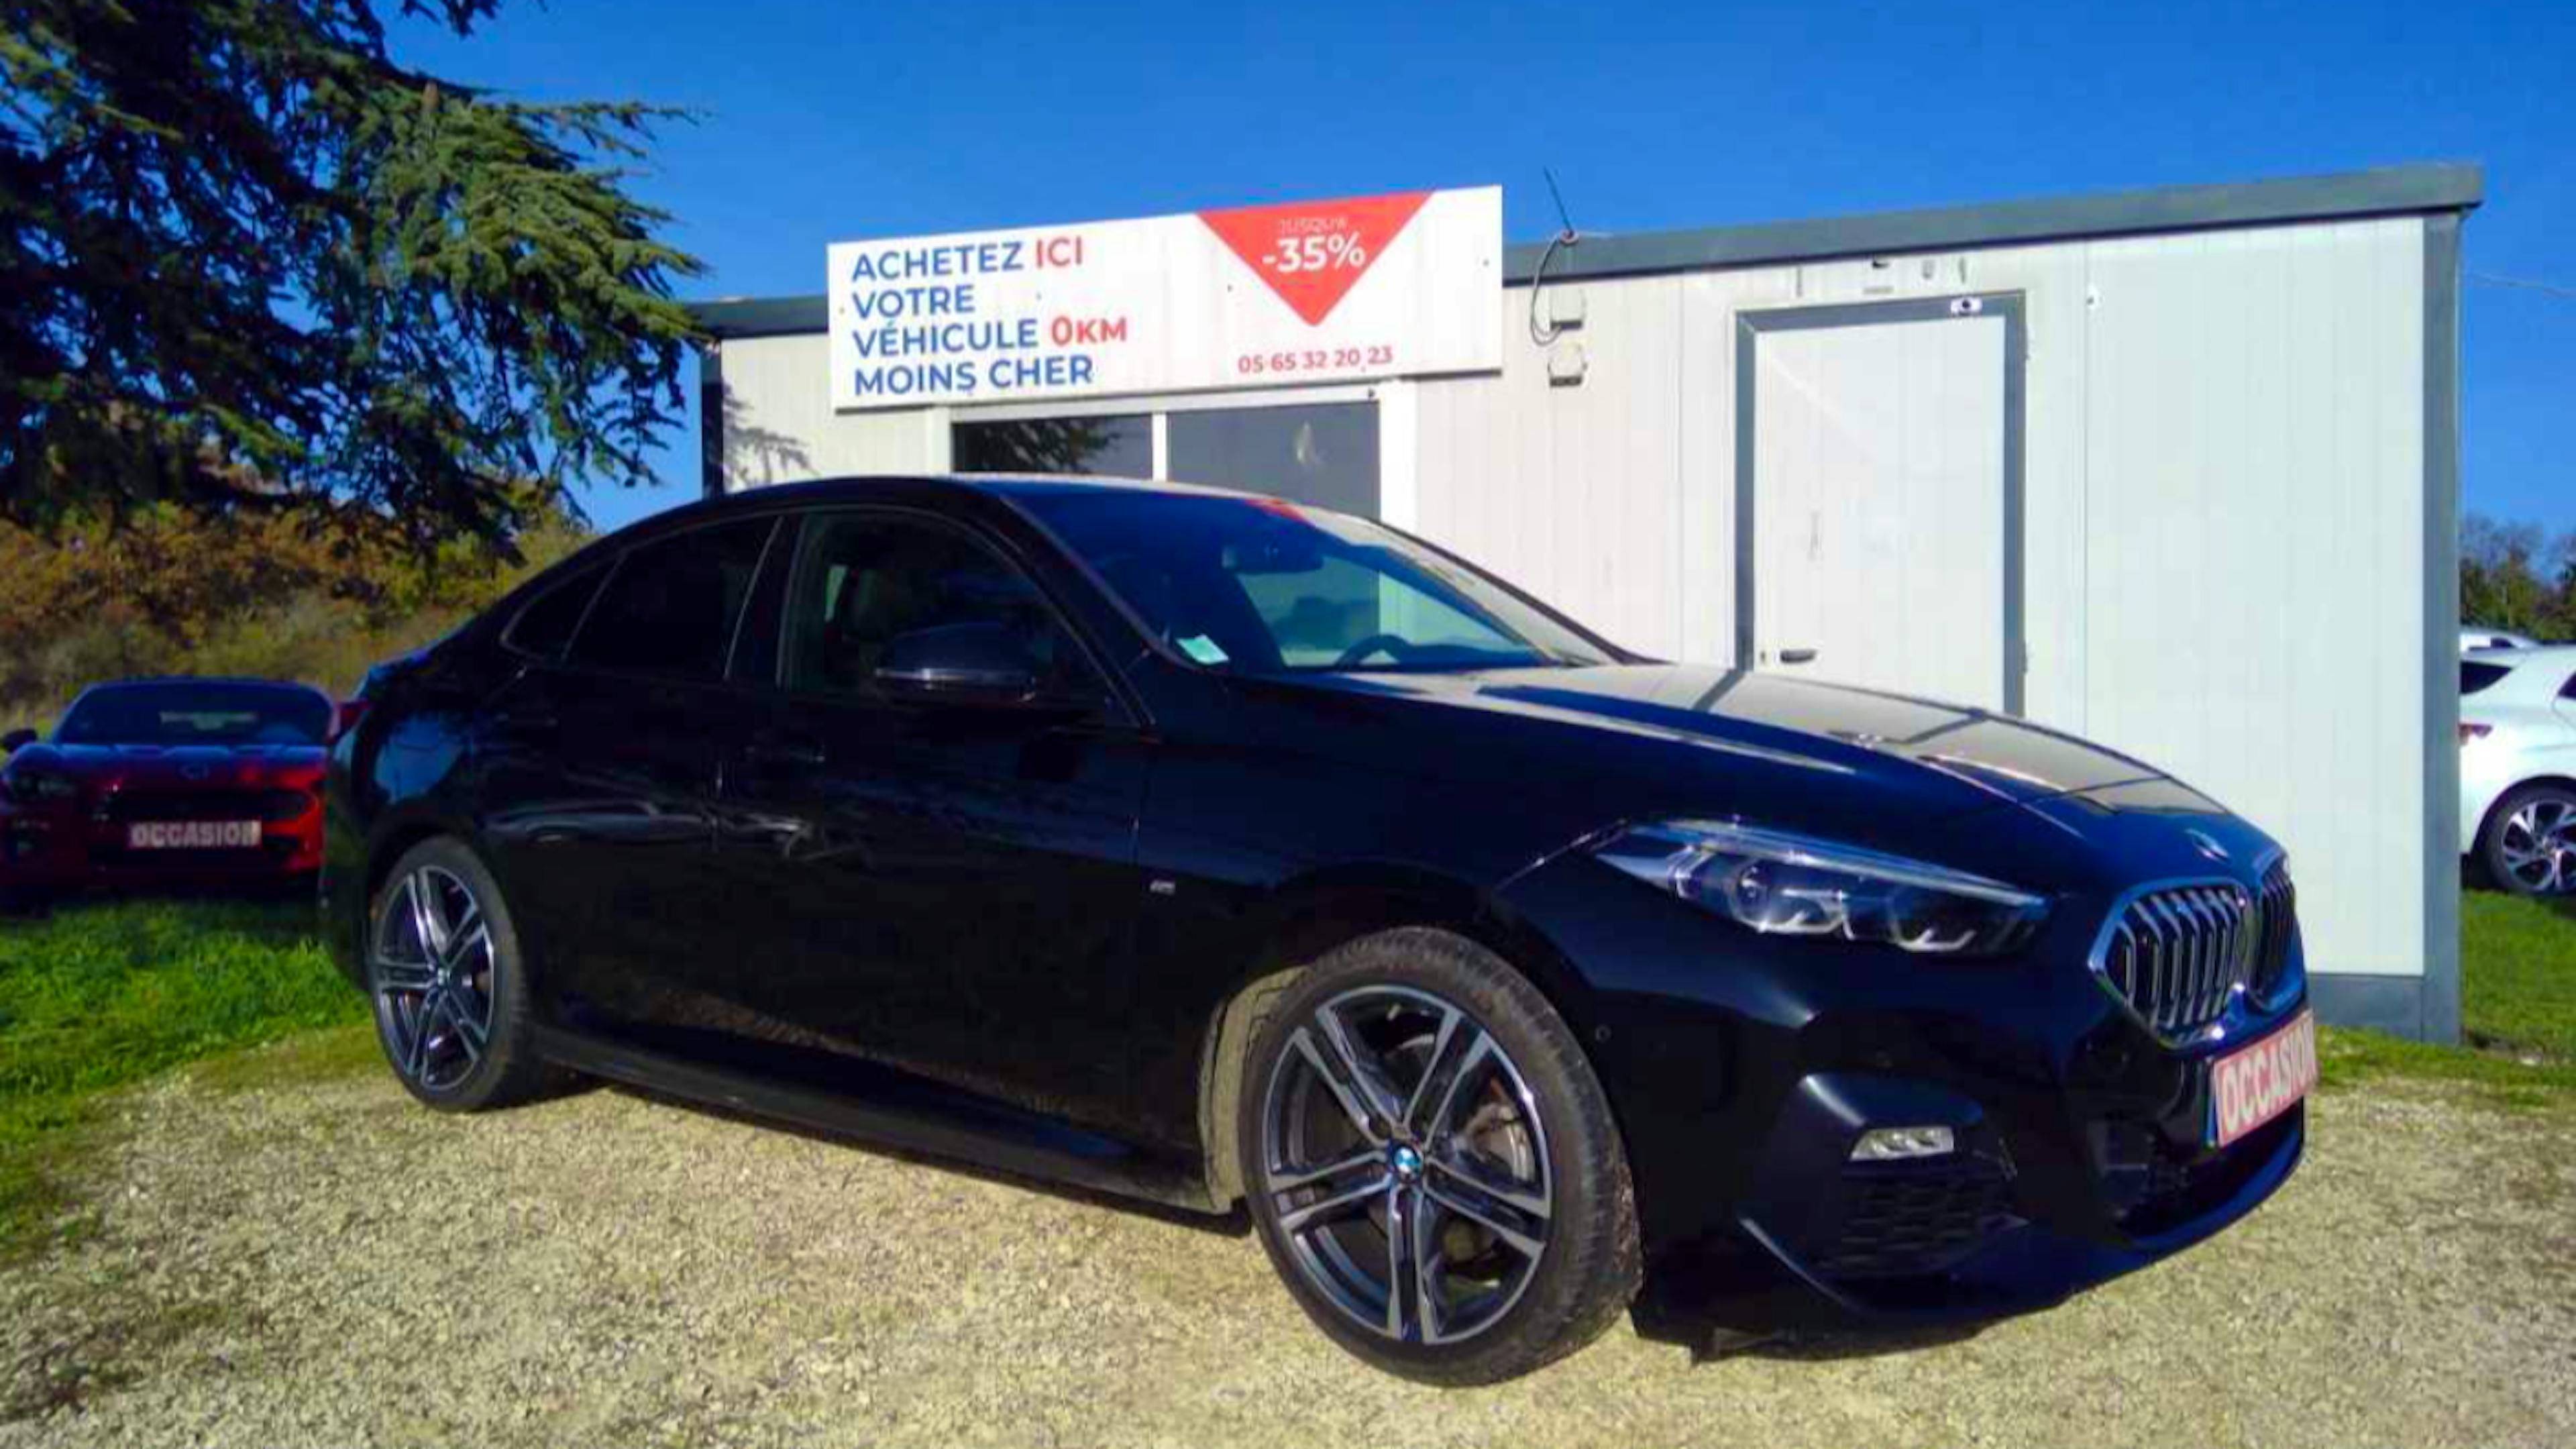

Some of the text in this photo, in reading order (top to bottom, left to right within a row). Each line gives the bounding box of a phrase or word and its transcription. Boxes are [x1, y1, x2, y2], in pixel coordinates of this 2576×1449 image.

[852, 236, 1082, 281] ACHETEZ ICI
[1263, 231, 1365, 272] -35%
[852, 284, 975, 319] VOTRE
[852, 316, 1127, 358] VÉHICULE 0KM
[855, 354, 1093, 397] MOINS CHER
[1238, 345, 1393, 374] 05 65 32 20 23
[132, 820, 262, 847] OCCASION
[2222, 1016, 2316, 1133] OCCASION
